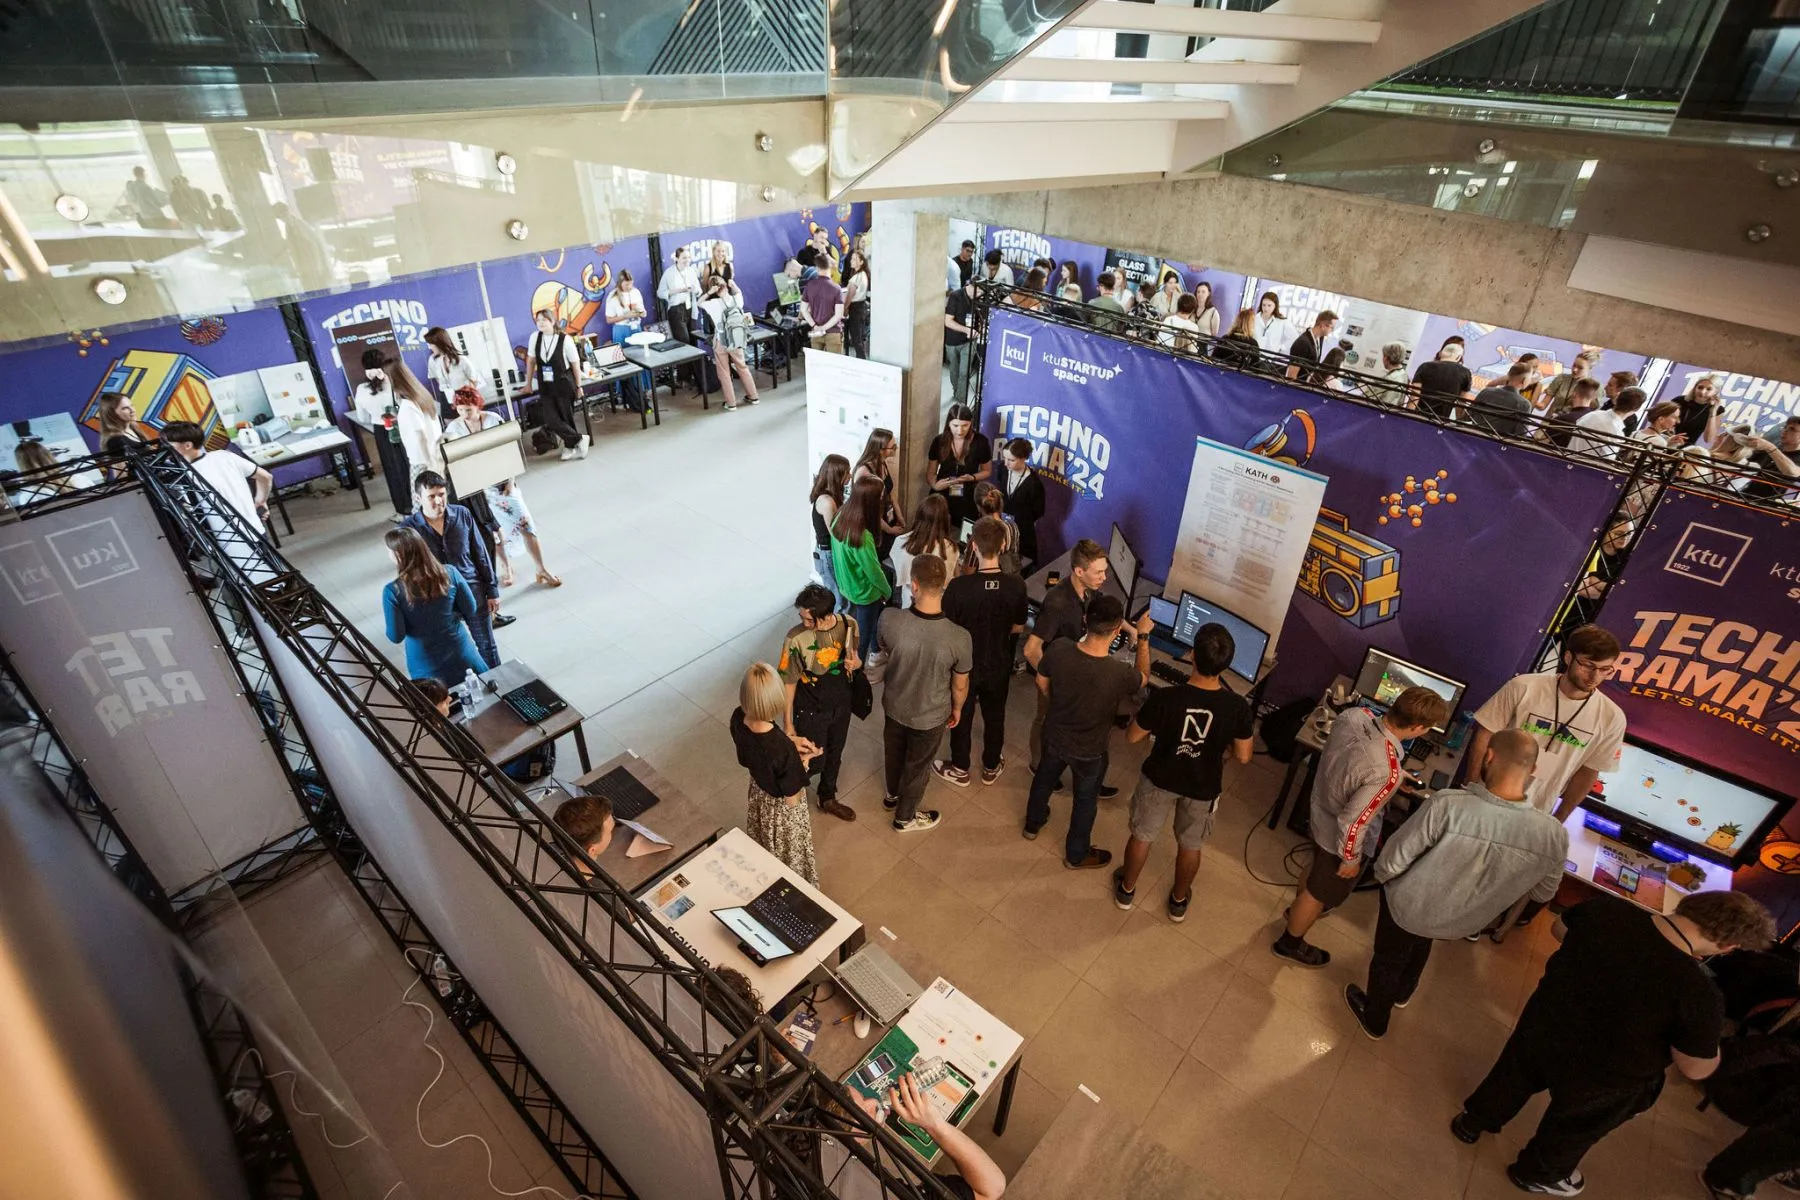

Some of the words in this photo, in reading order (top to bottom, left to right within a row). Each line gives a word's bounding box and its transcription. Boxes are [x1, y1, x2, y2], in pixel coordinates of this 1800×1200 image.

[992, 229, 1051, 258] TECHNO
[1118, 258, 1146, 271] GLASS
[1005, 345, 1026, 361] ktu
[1042, 351, 1114, 381] ktuSTARTUP
[1053, 367, 1088, 385] space
[996, 404, 1112, 472] TECHNO
[992, 437, 1106, 501] RMA'24
[1244, 466, 1269, 481] KATH
[1673, 562, 1691, 572] 1922
[1682, 543, 1728, 569] ktu
[1630, 686, 1695, 707] LET'S
[1699, 704, 1768, 735] MAKE
